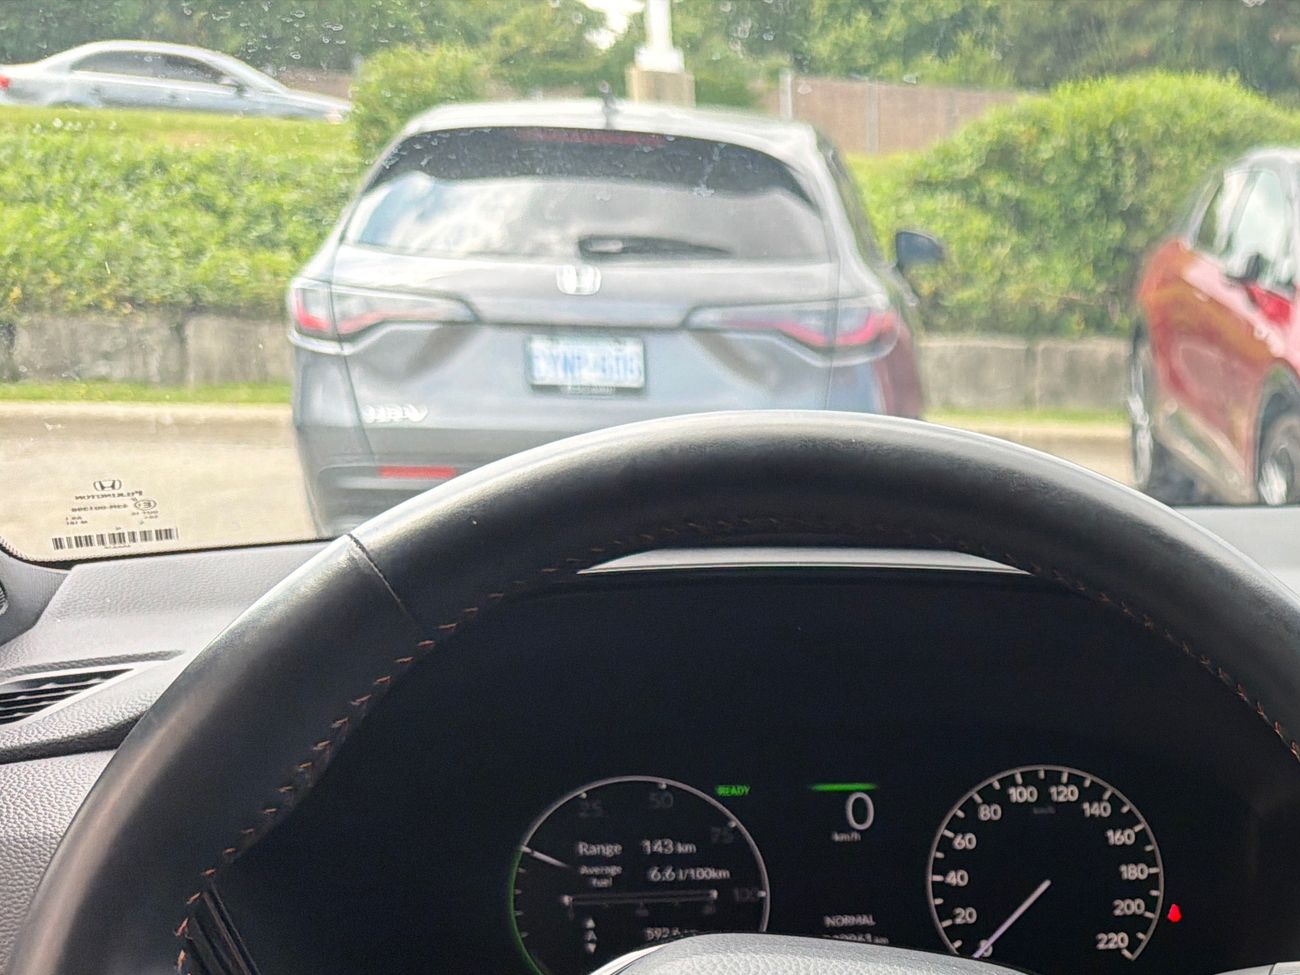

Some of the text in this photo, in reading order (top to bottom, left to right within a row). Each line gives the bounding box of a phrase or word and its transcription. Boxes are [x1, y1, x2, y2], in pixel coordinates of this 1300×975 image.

[715, 785, 750, 797] READY
[1008, 786, 1038, 803] 100
[1049, 785, 1079, 802] 120
[845, 792, 875, 830] 0
[977, 804, 1001, 821] 80
[1082, 802, 1112, 818] 140
[831, 831, 861, 843] km/h
[952, 833, 977, 850] 60
[1106, 829, 1136, 846] 160
[578, 839, 697, 857] Range 143 km
[579, 865, 623, 877] Average
[648, 866, 676, 882] 6.6
[944, 870, 969, 887] 40
[1119, 863, 1148, 880] 180
[590, 878, 613, 888] fuel
[953, 907, 978, 924] 20
[1113, 899, 1146, 915] 200
[824, 914, 876, 928] NORMAL
[1096, 933, 1130, 950] 220
